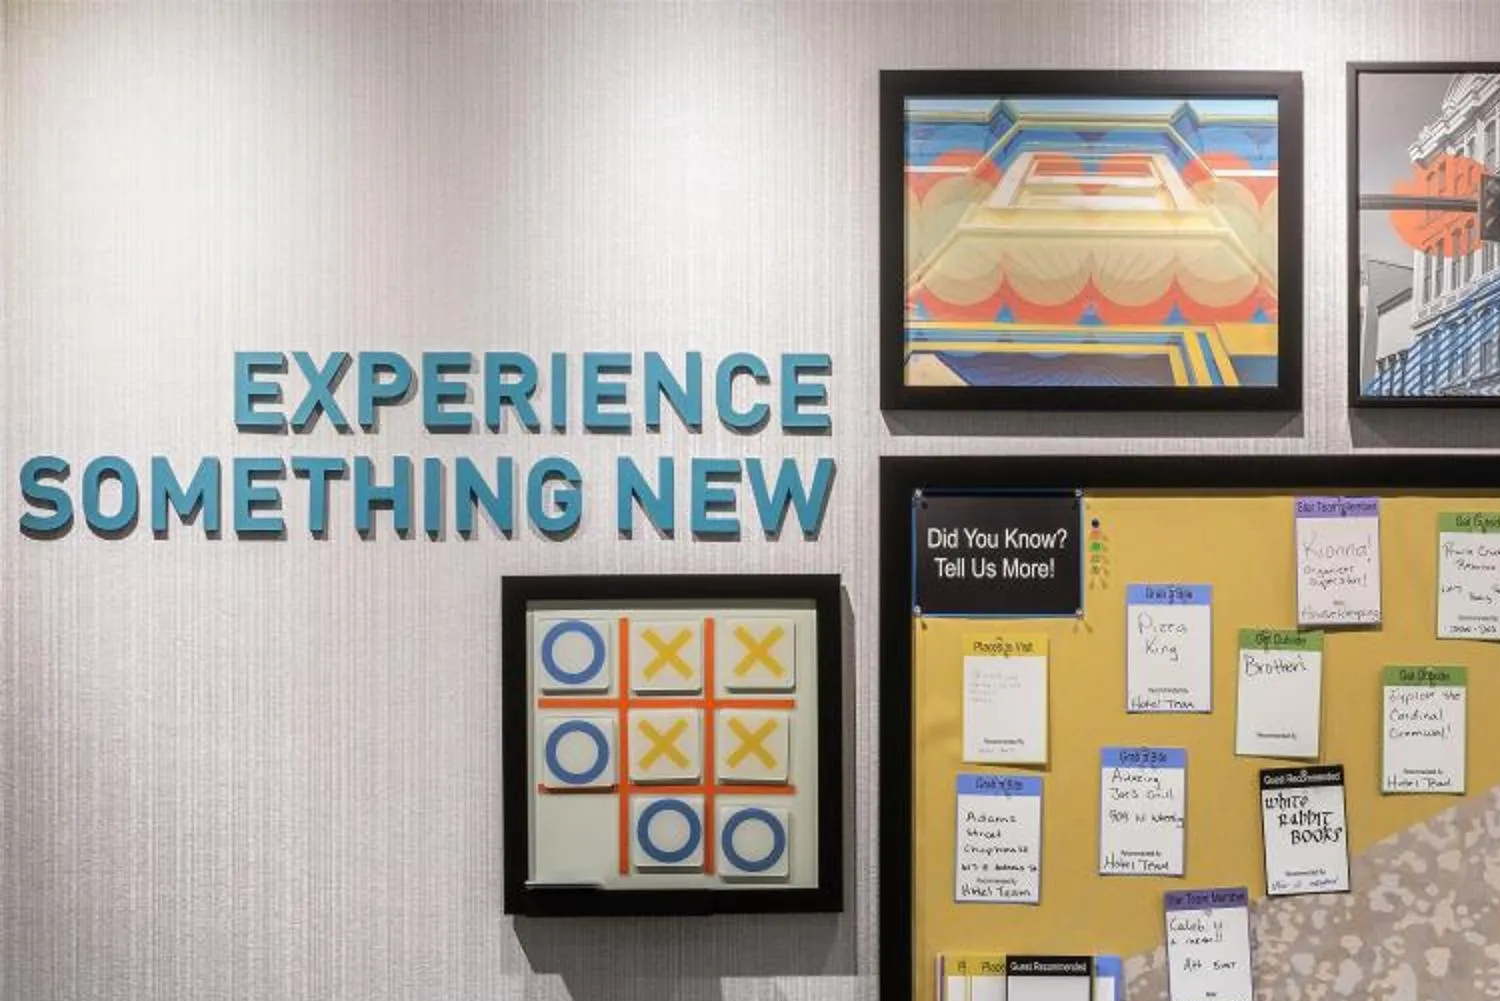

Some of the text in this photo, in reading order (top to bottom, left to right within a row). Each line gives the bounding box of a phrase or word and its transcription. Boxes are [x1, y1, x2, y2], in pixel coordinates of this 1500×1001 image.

[234, 351, 834, 434] EXPERIENCE
[19, 456, 836, 540] SOMETHING NEW
[927, 527, 1068, 550] Did You Know?
[934, 557, 1055, 578] Tell Us More!
[1009, 961, 1088, 973] Guest Recommended
